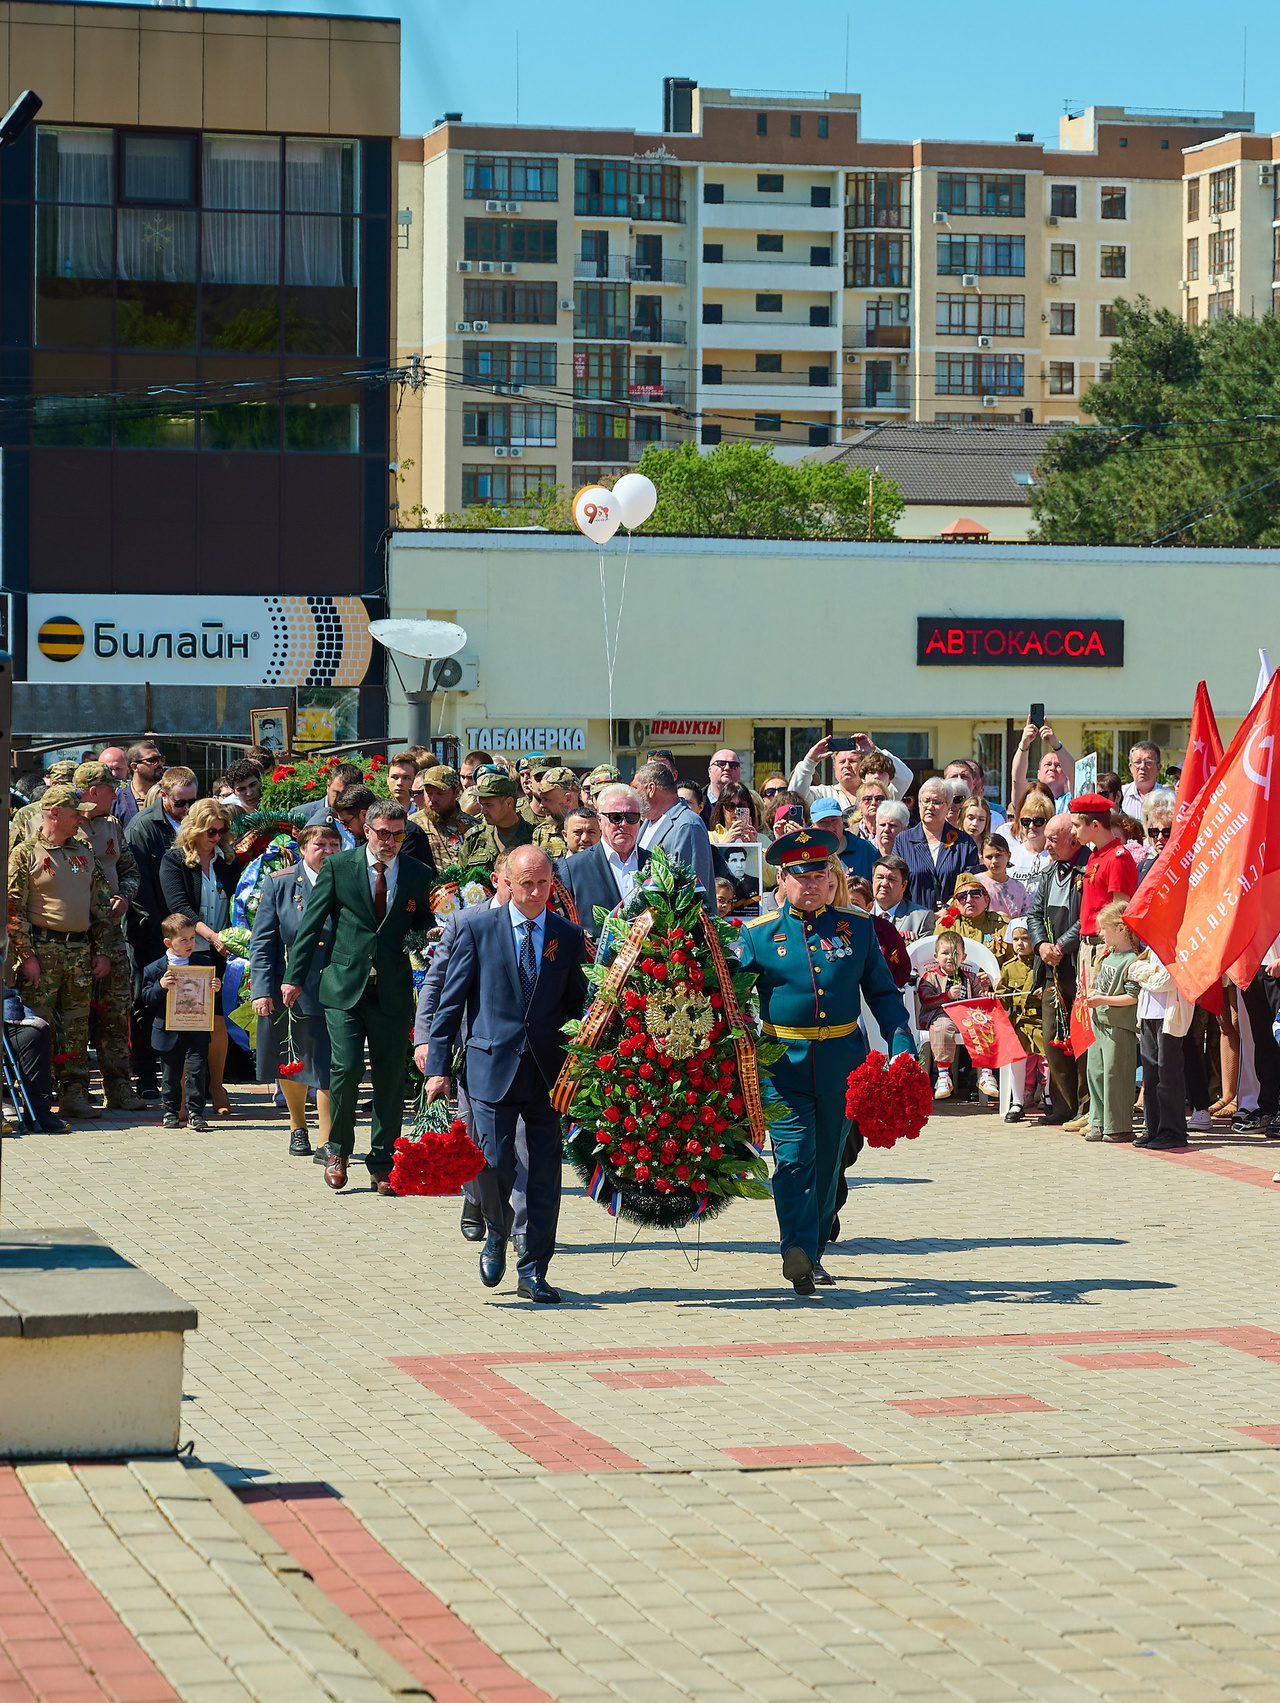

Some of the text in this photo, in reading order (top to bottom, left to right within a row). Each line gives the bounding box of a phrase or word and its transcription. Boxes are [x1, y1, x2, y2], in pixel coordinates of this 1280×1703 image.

[925, 628, 1106, 657] АВТОКАССА
[466, 727, 586, 751] ТАБАКЕРКА
[651, 719, 722, 735] ПРОДУКТЫ
